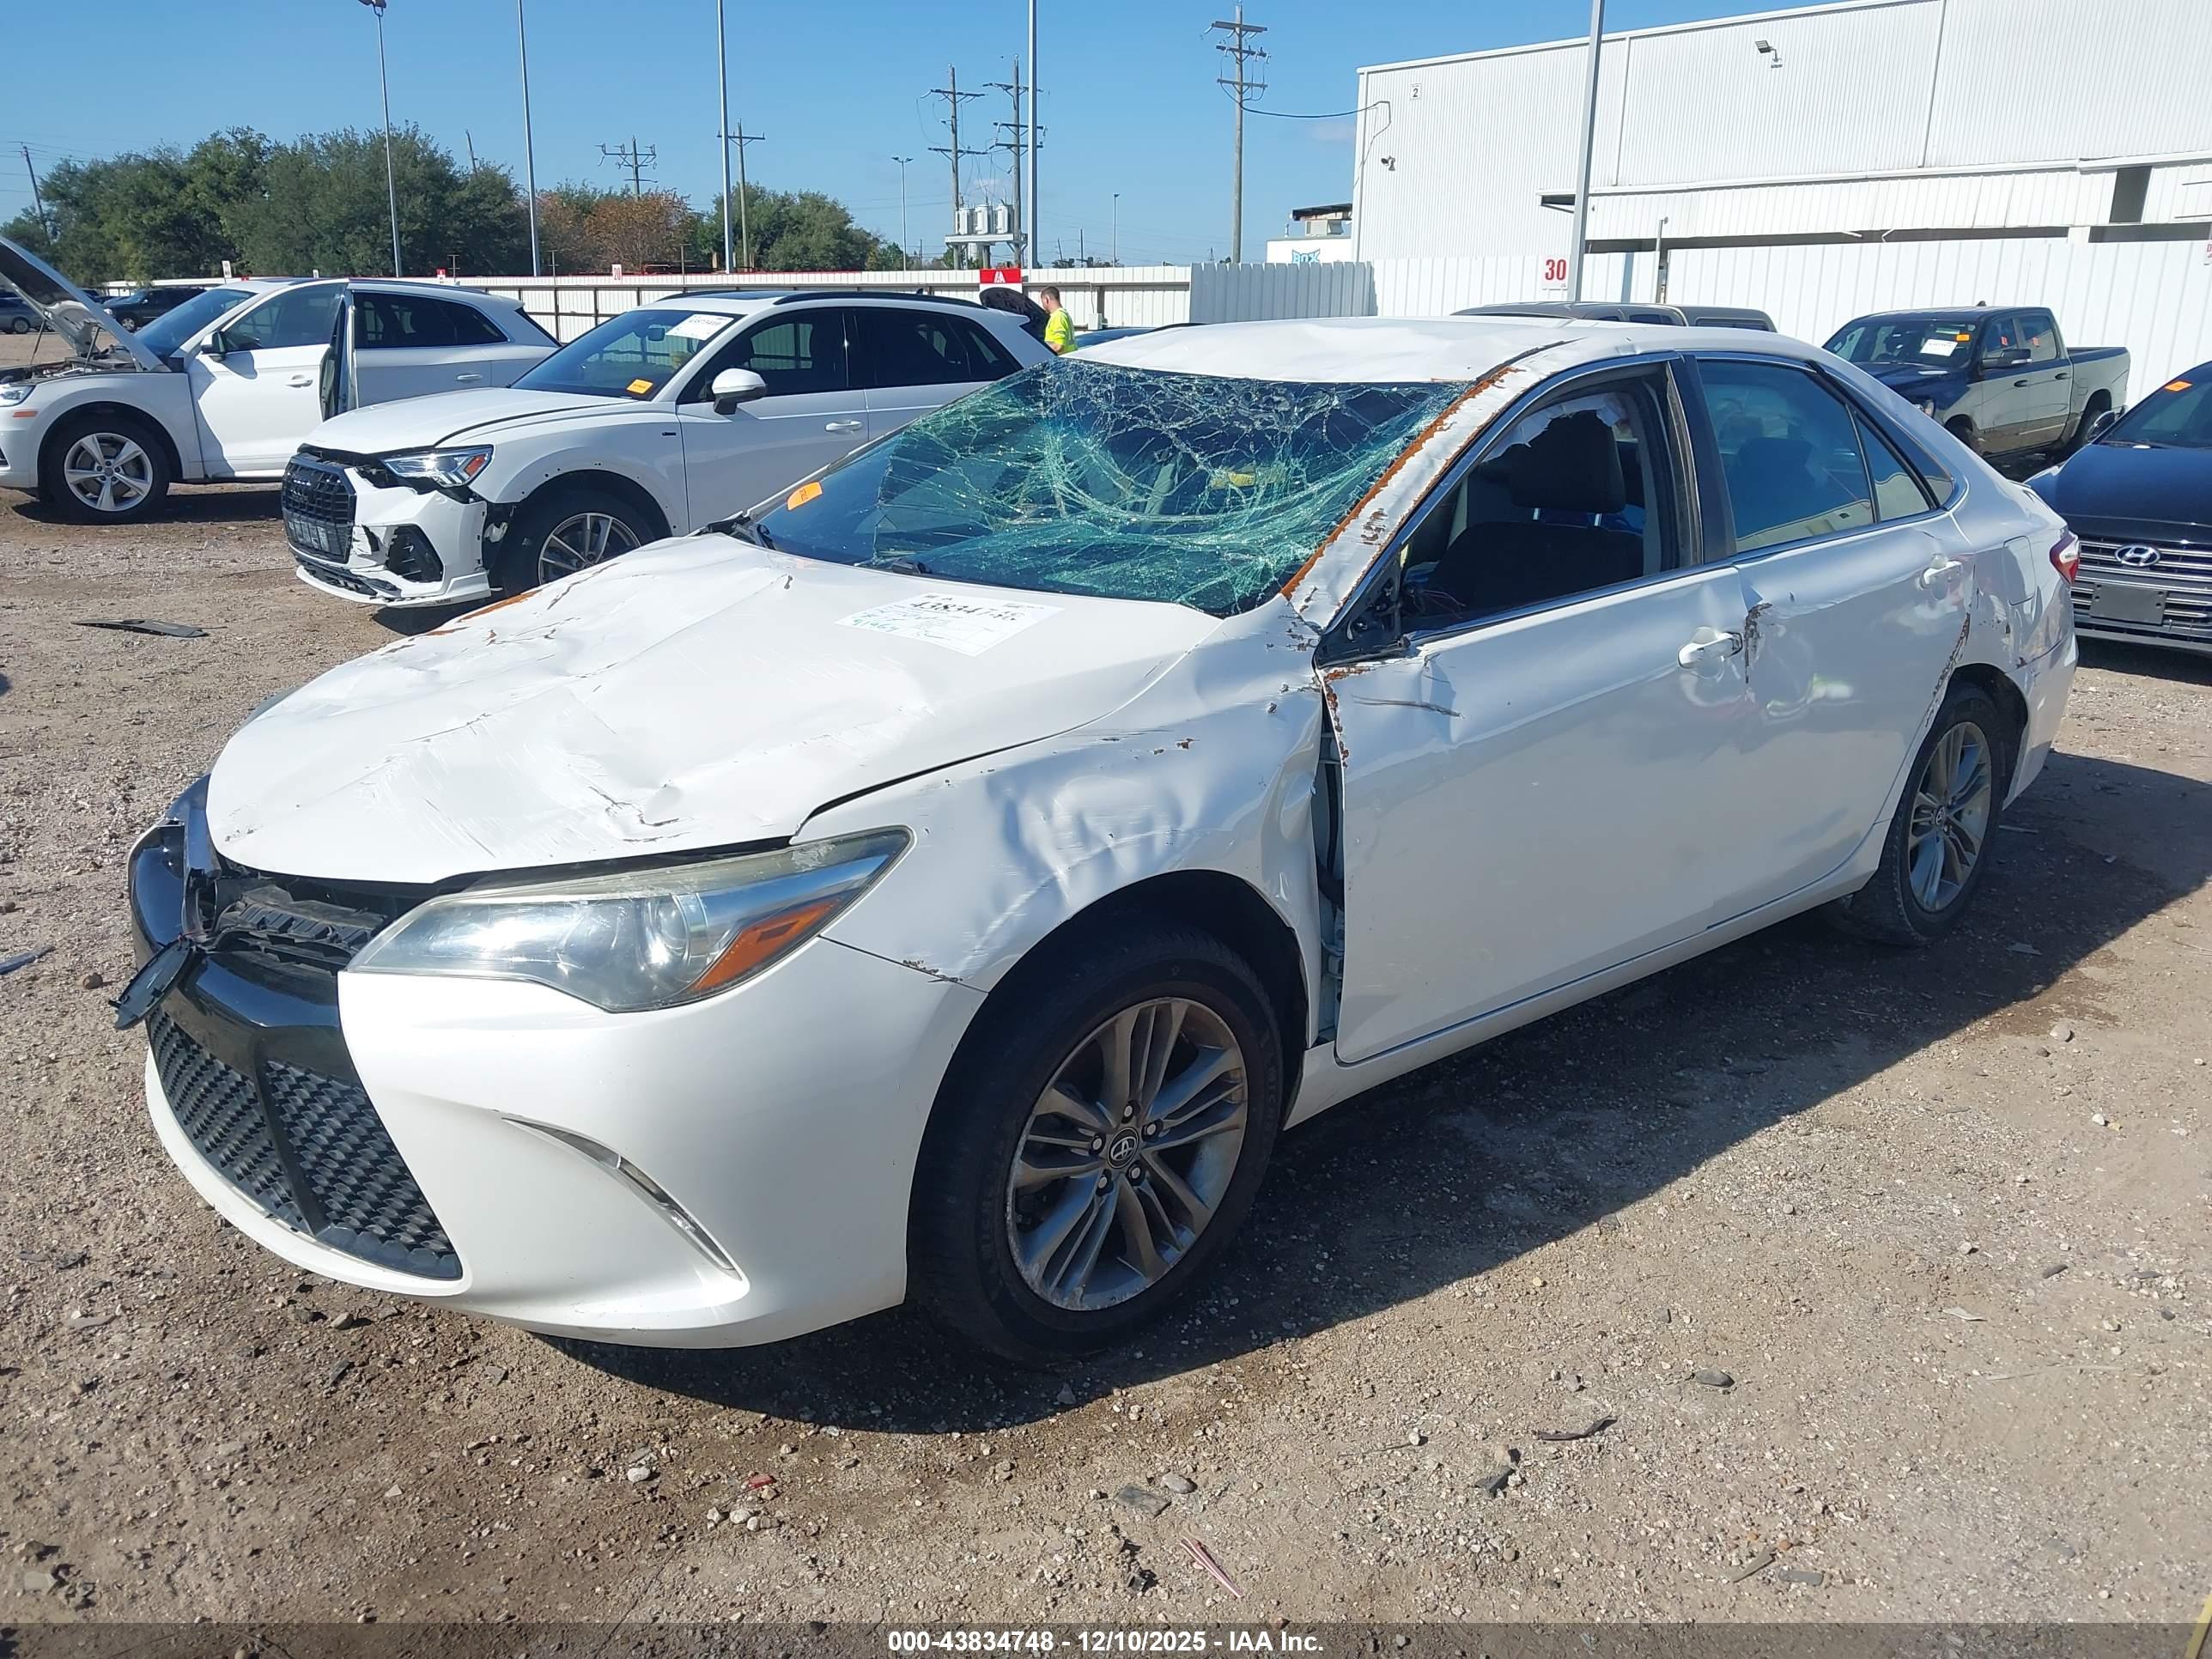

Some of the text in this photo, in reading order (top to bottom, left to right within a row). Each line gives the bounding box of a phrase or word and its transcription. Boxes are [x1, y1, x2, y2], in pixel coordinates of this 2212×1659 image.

[1413, 88, 1419, 98] 2
[1291, 249, 1320, 263] BOX
[1545, 258, 1567, 281] 30
